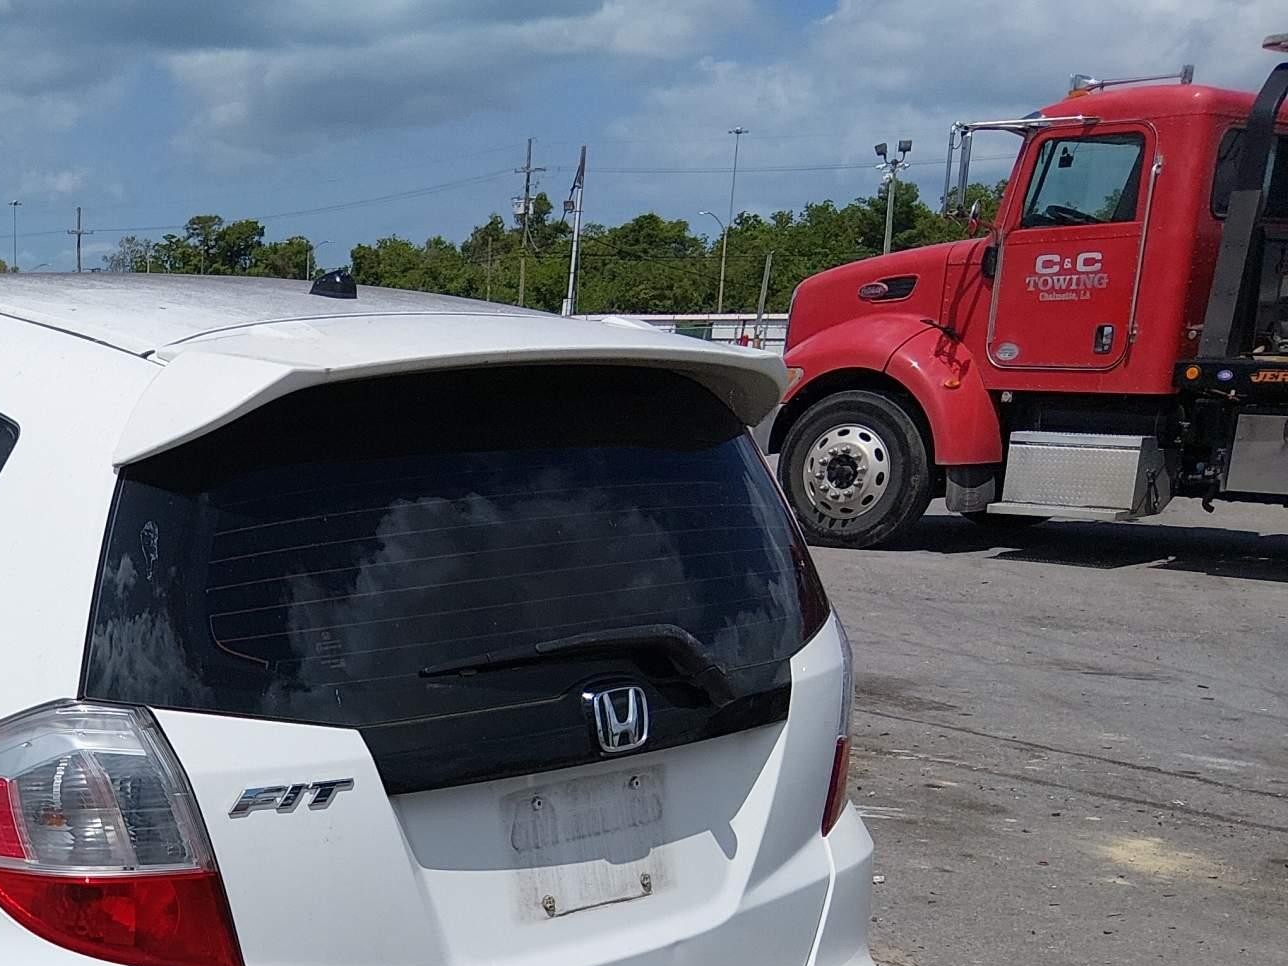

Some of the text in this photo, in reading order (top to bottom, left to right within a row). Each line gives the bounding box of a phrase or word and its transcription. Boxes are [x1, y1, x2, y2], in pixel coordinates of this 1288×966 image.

[1036, 252, 1102, 274] C & C
[1026, 274, 1108, 291] TOWING
[228, 778, 355, 819] FIT
